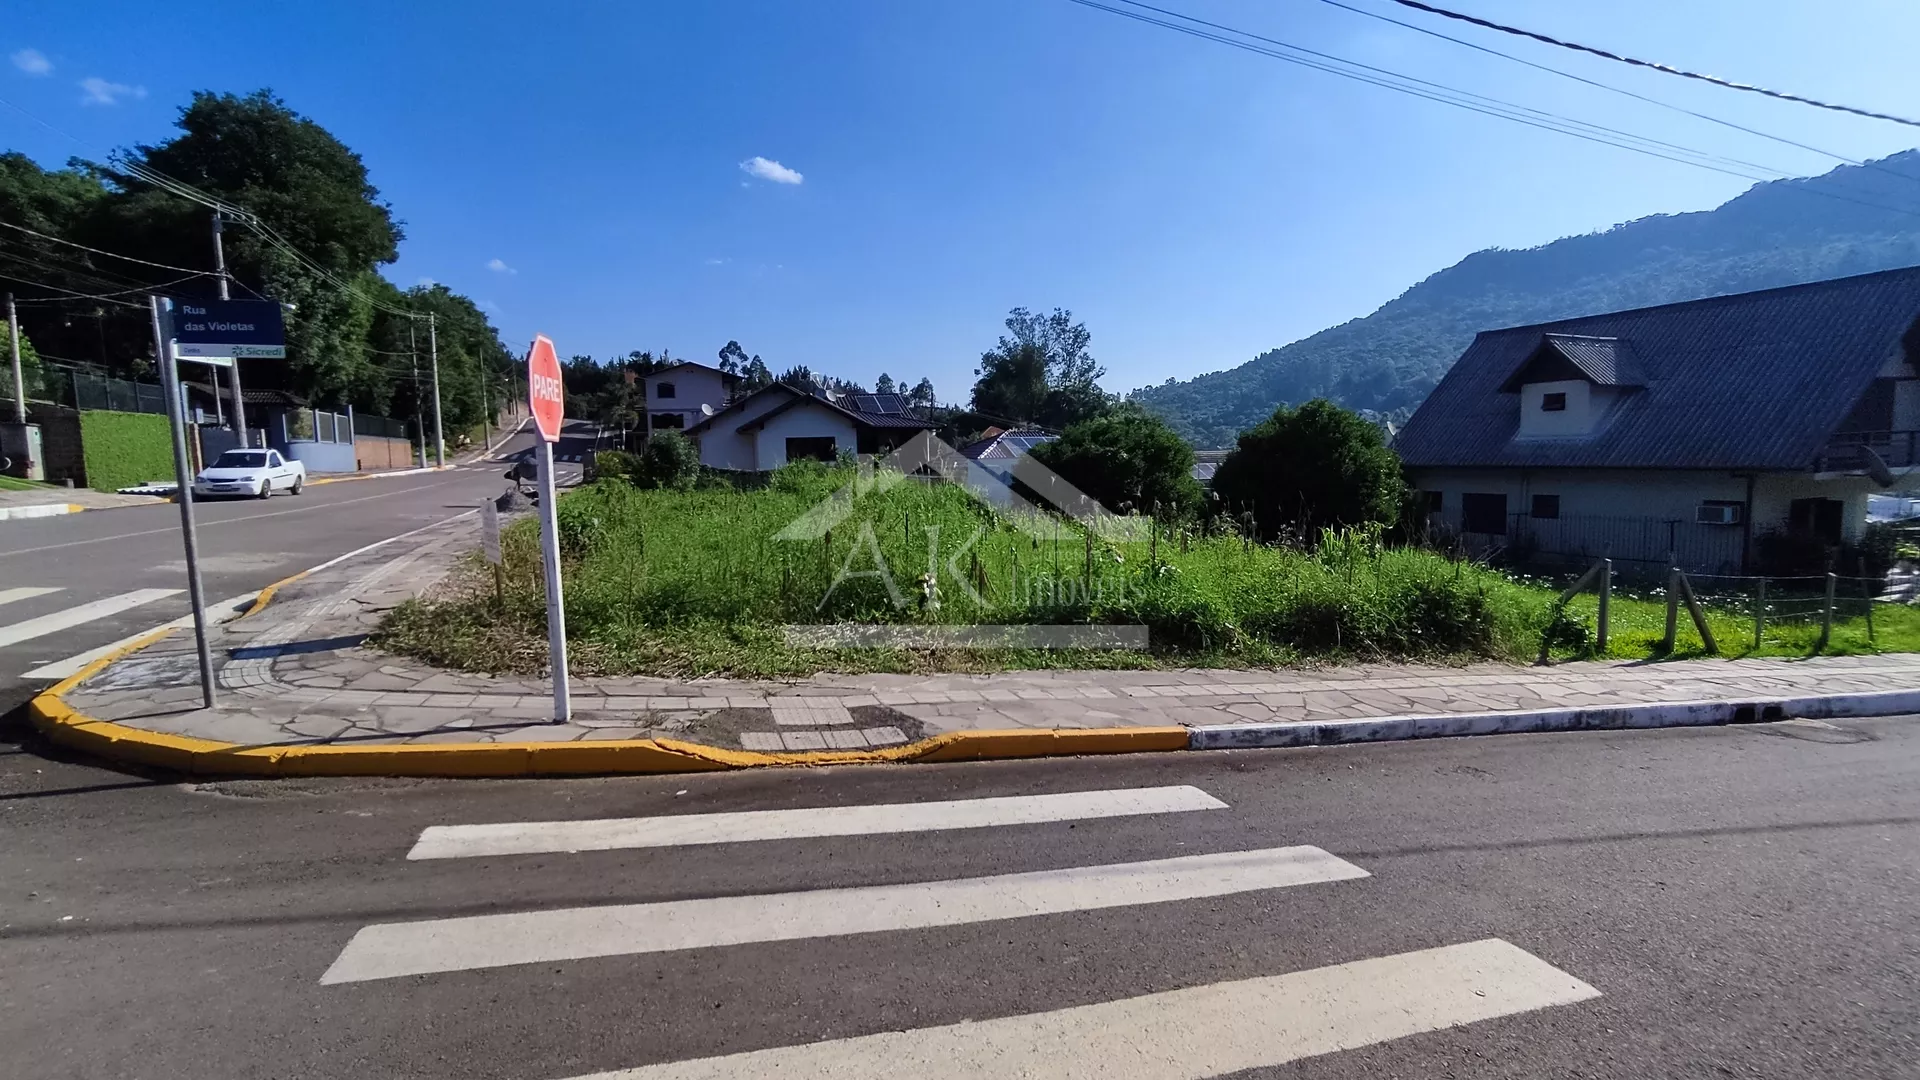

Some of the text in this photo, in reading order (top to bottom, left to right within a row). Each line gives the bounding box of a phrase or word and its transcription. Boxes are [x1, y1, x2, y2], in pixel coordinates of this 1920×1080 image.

[183, 305, 206, 315] Rua
[184, 321, 255, 331] das Violetas
[246, 347, 281, 356] Sicredi
[533, 374, 560, 403] PARE
